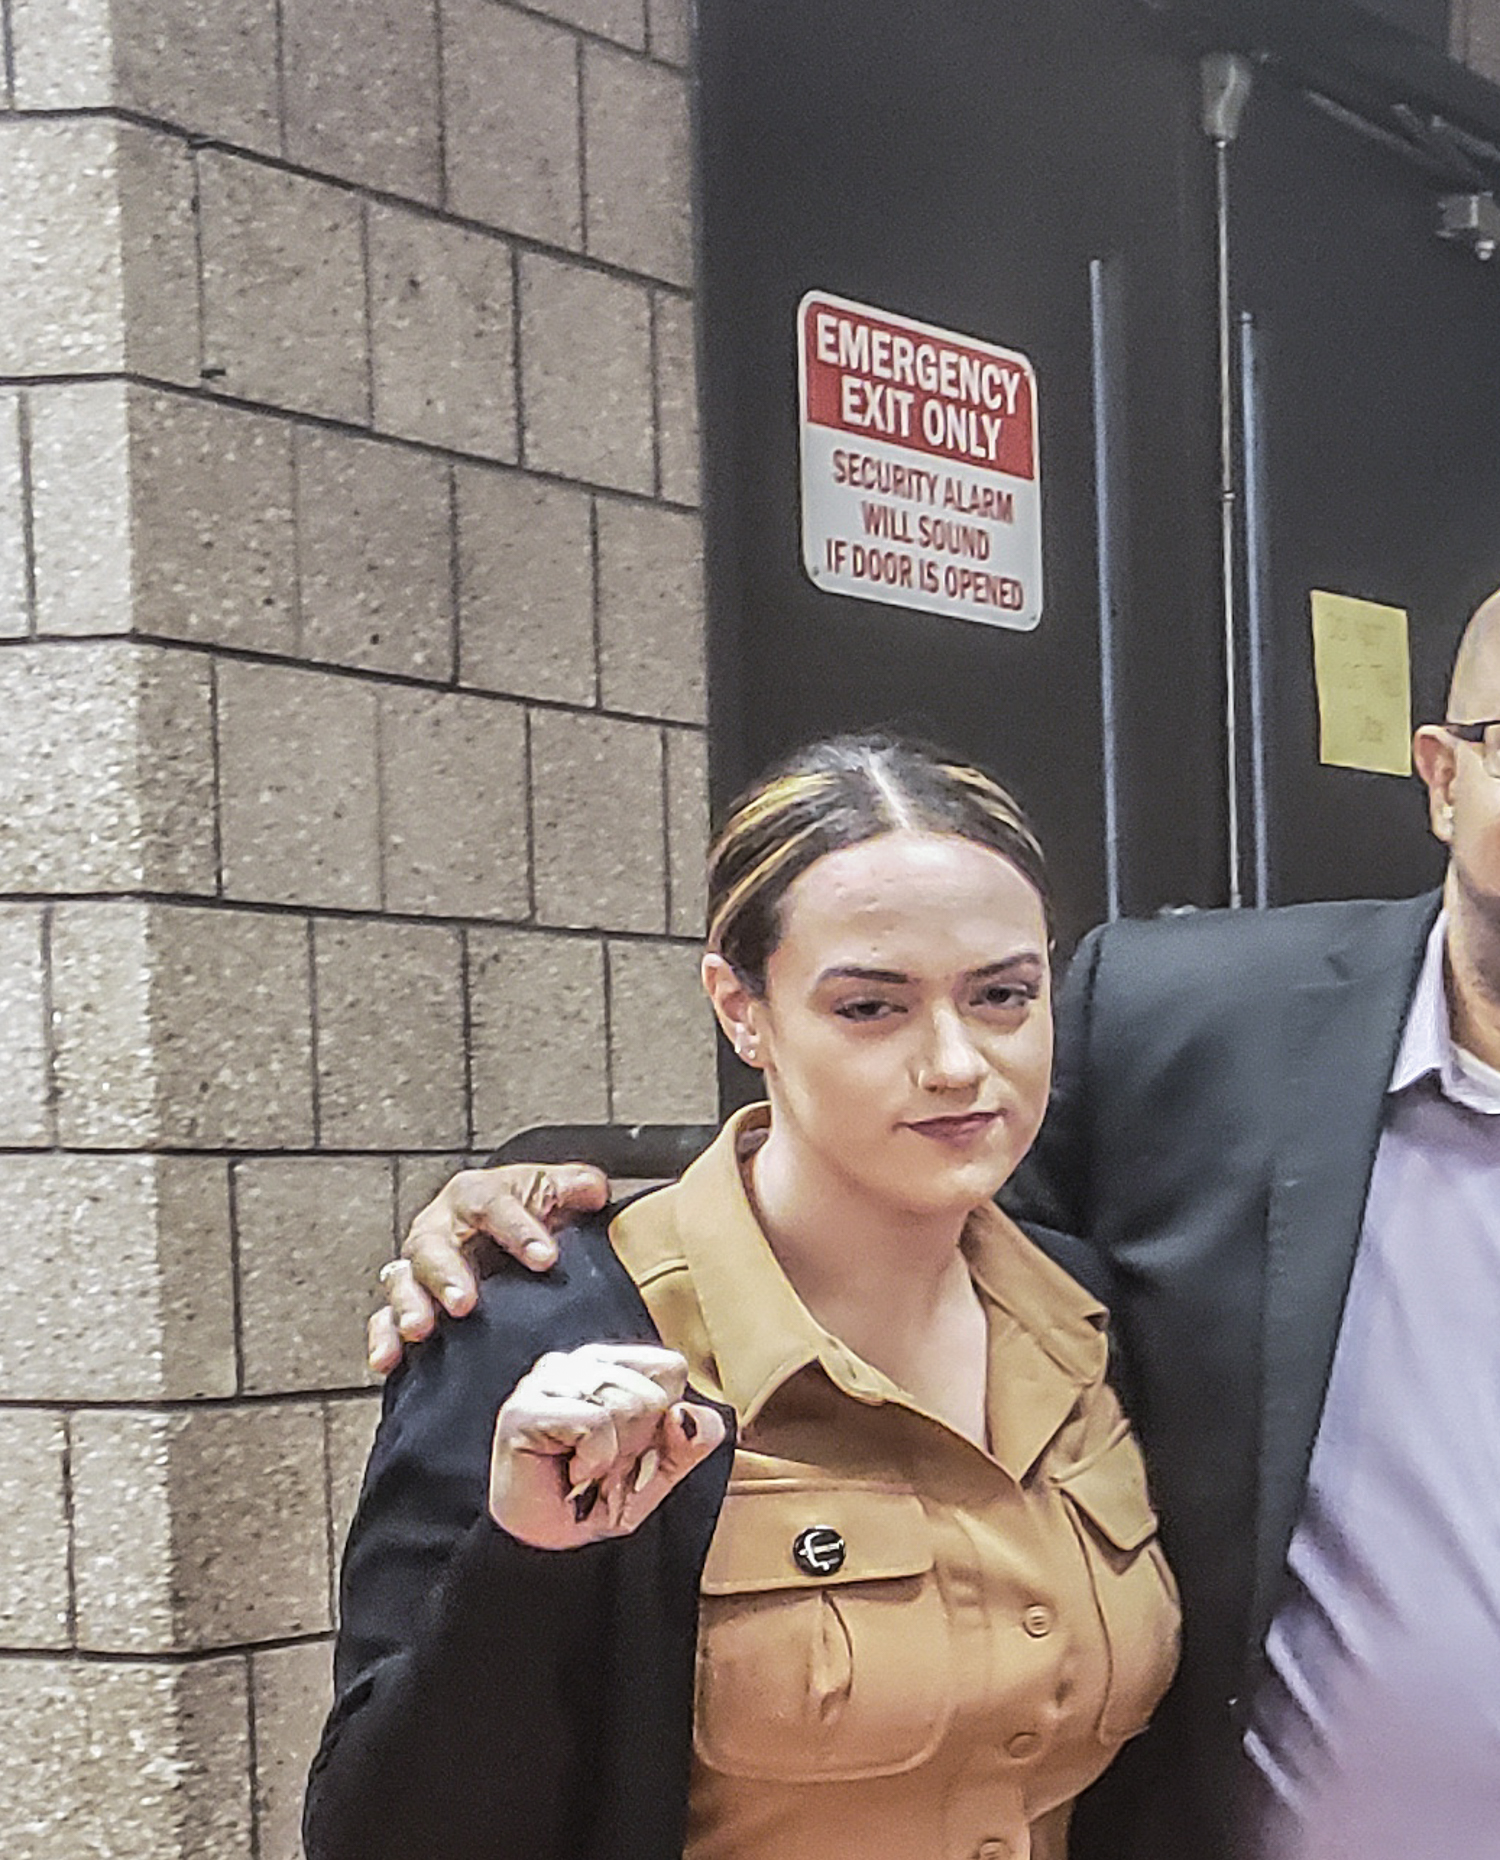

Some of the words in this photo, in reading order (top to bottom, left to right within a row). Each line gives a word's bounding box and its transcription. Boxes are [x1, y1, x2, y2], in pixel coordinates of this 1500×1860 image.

[817, 311, 1021, 415] EMERGENCY
[841, 374, 915, 437] EXIT
[922, 398, 1003, 461] ONLY
[832, 448, 940, 505] SECURITY
[943, 476, 1014, 524] ALARM
[861, 500, 914, 544] WILL
[918, 514, 990, 561] SOUND
[826, 537, 848, 574] IF
[853, 544, 913, 589] DOOR
[919, 557, 939, 594] IS
[944, 565, 1024, 612] OPENED
